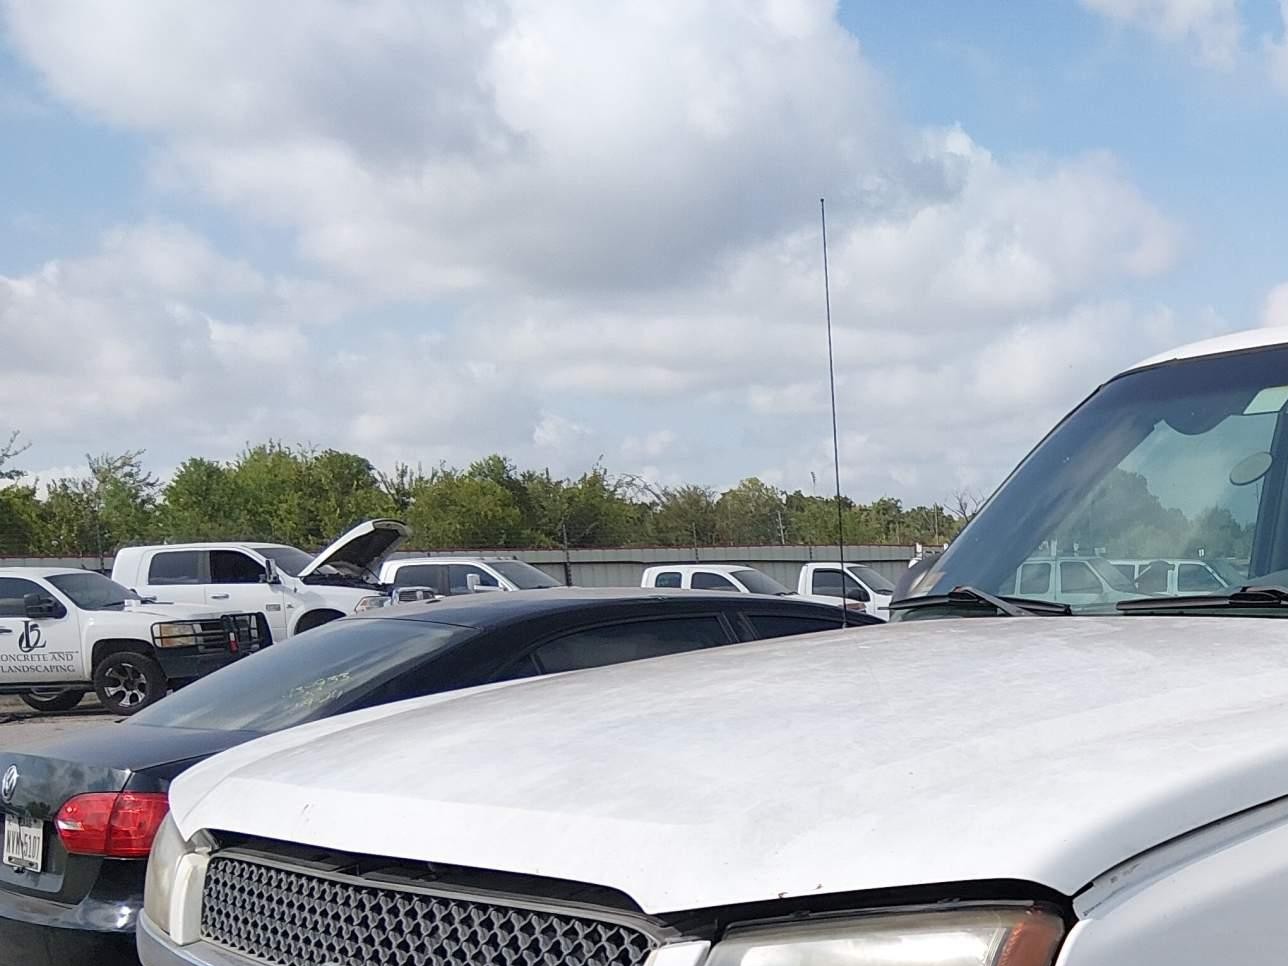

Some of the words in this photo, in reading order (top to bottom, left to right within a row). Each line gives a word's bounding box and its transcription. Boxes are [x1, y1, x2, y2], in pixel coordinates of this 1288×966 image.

[0, 654, 48, 662] ONCRETE
[51, 654, 74, 662] AND
[0, 665, 76, 673] LANDSCAPING
